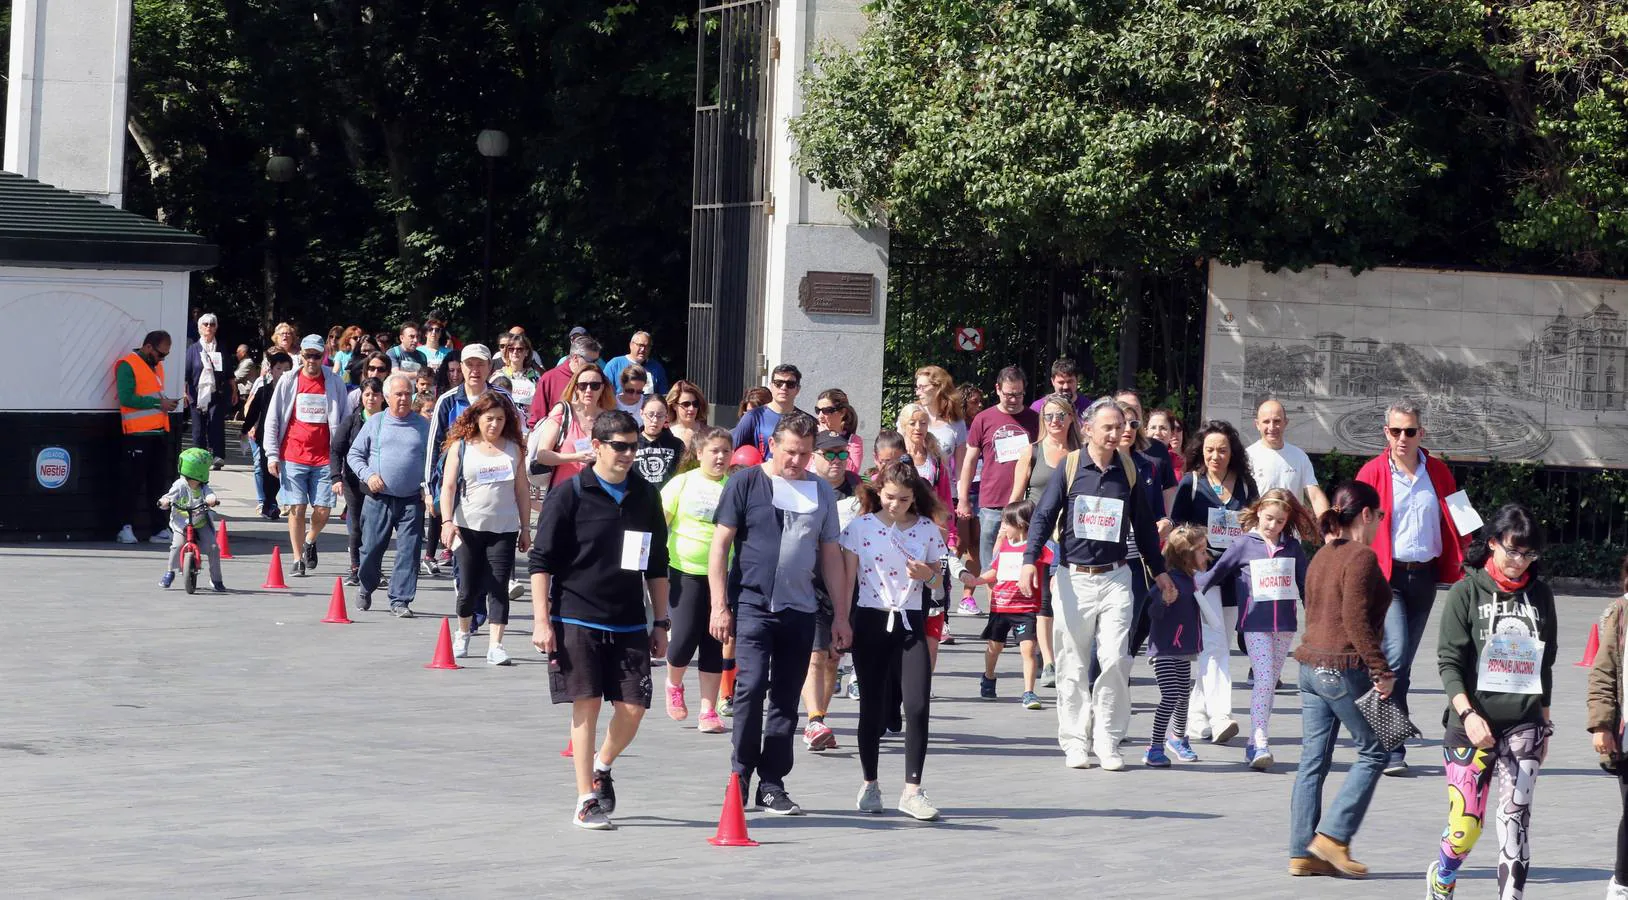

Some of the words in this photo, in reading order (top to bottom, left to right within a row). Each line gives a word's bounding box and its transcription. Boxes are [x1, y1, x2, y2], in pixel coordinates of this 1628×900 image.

[1077, 513, 1097, 525] RAMOS
[1098, 515, 1117, 528] TEJERO
[1478, 600, 1540, 621] IRELAND
